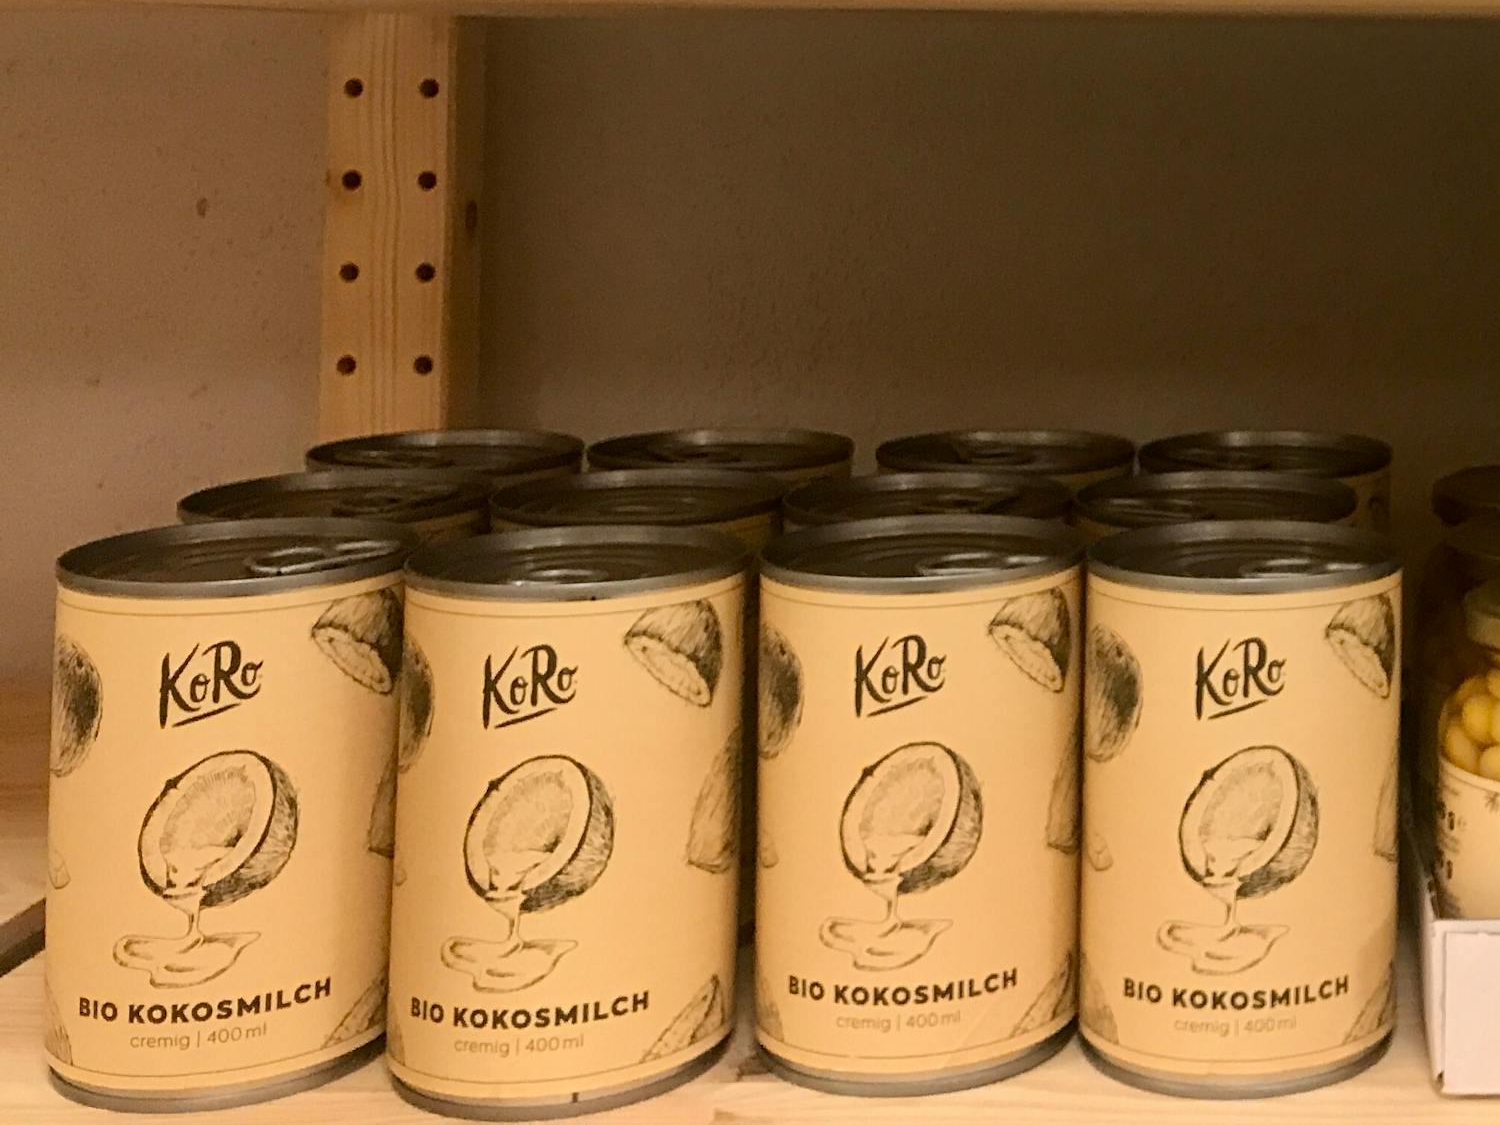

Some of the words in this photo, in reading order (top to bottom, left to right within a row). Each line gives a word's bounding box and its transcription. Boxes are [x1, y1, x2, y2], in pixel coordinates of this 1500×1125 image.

[159, 639, 264, 729] KoRo
[482, 643, 577, 730] KoRo
[854, 634, 946, 718] KoRo
[1195, 636, 1287, 720] KoRo
[78, 995, 119, 1022] BIO
[128, 976, 332, 1024] KOKOSMILCH
[788, 975, 824, 1002] BIO
[833, 968, 1018, 1007] KOKOSMILCH
[1123, 977, 1162, 1004] BIO
[1172, 975, 1350, 1011] KOKOSMILCH
[410, 996, 445, 1023] BIO
[453, 990, 650, 1030] KOKOSMILCH
[835, 1014, 892, 1033] cremig
[1173, 1017, 1230, 1037] cremig
[129, 1032, 191, 1051] cremig
[453, 1037, 510, 1057] cremig
